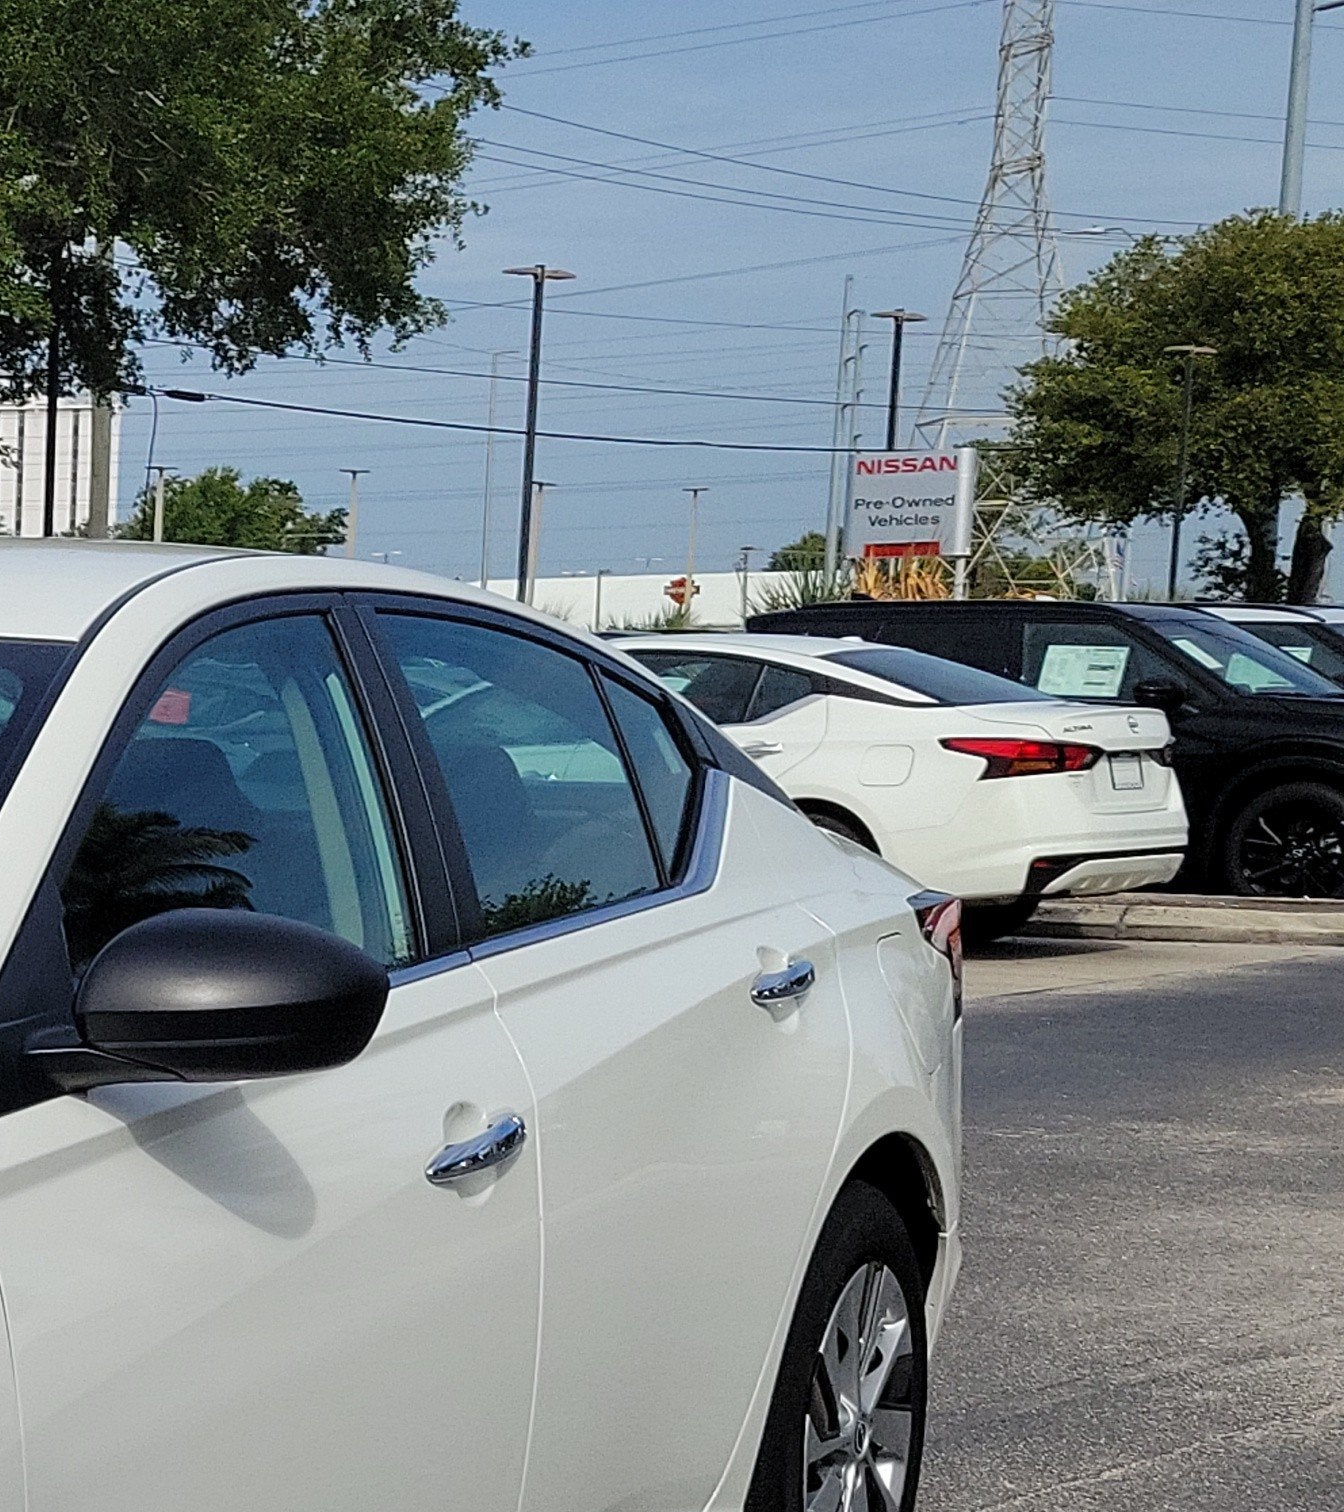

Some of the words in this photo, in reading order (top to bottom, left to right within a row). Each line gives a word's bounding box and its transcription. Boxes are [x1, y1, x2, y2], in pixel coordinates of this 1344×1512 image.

[856, 455, 958, 475] NISSAN
[853, 495, 956, 510] Pre-Owned
[868, 514, 940, 527] Vehicles
